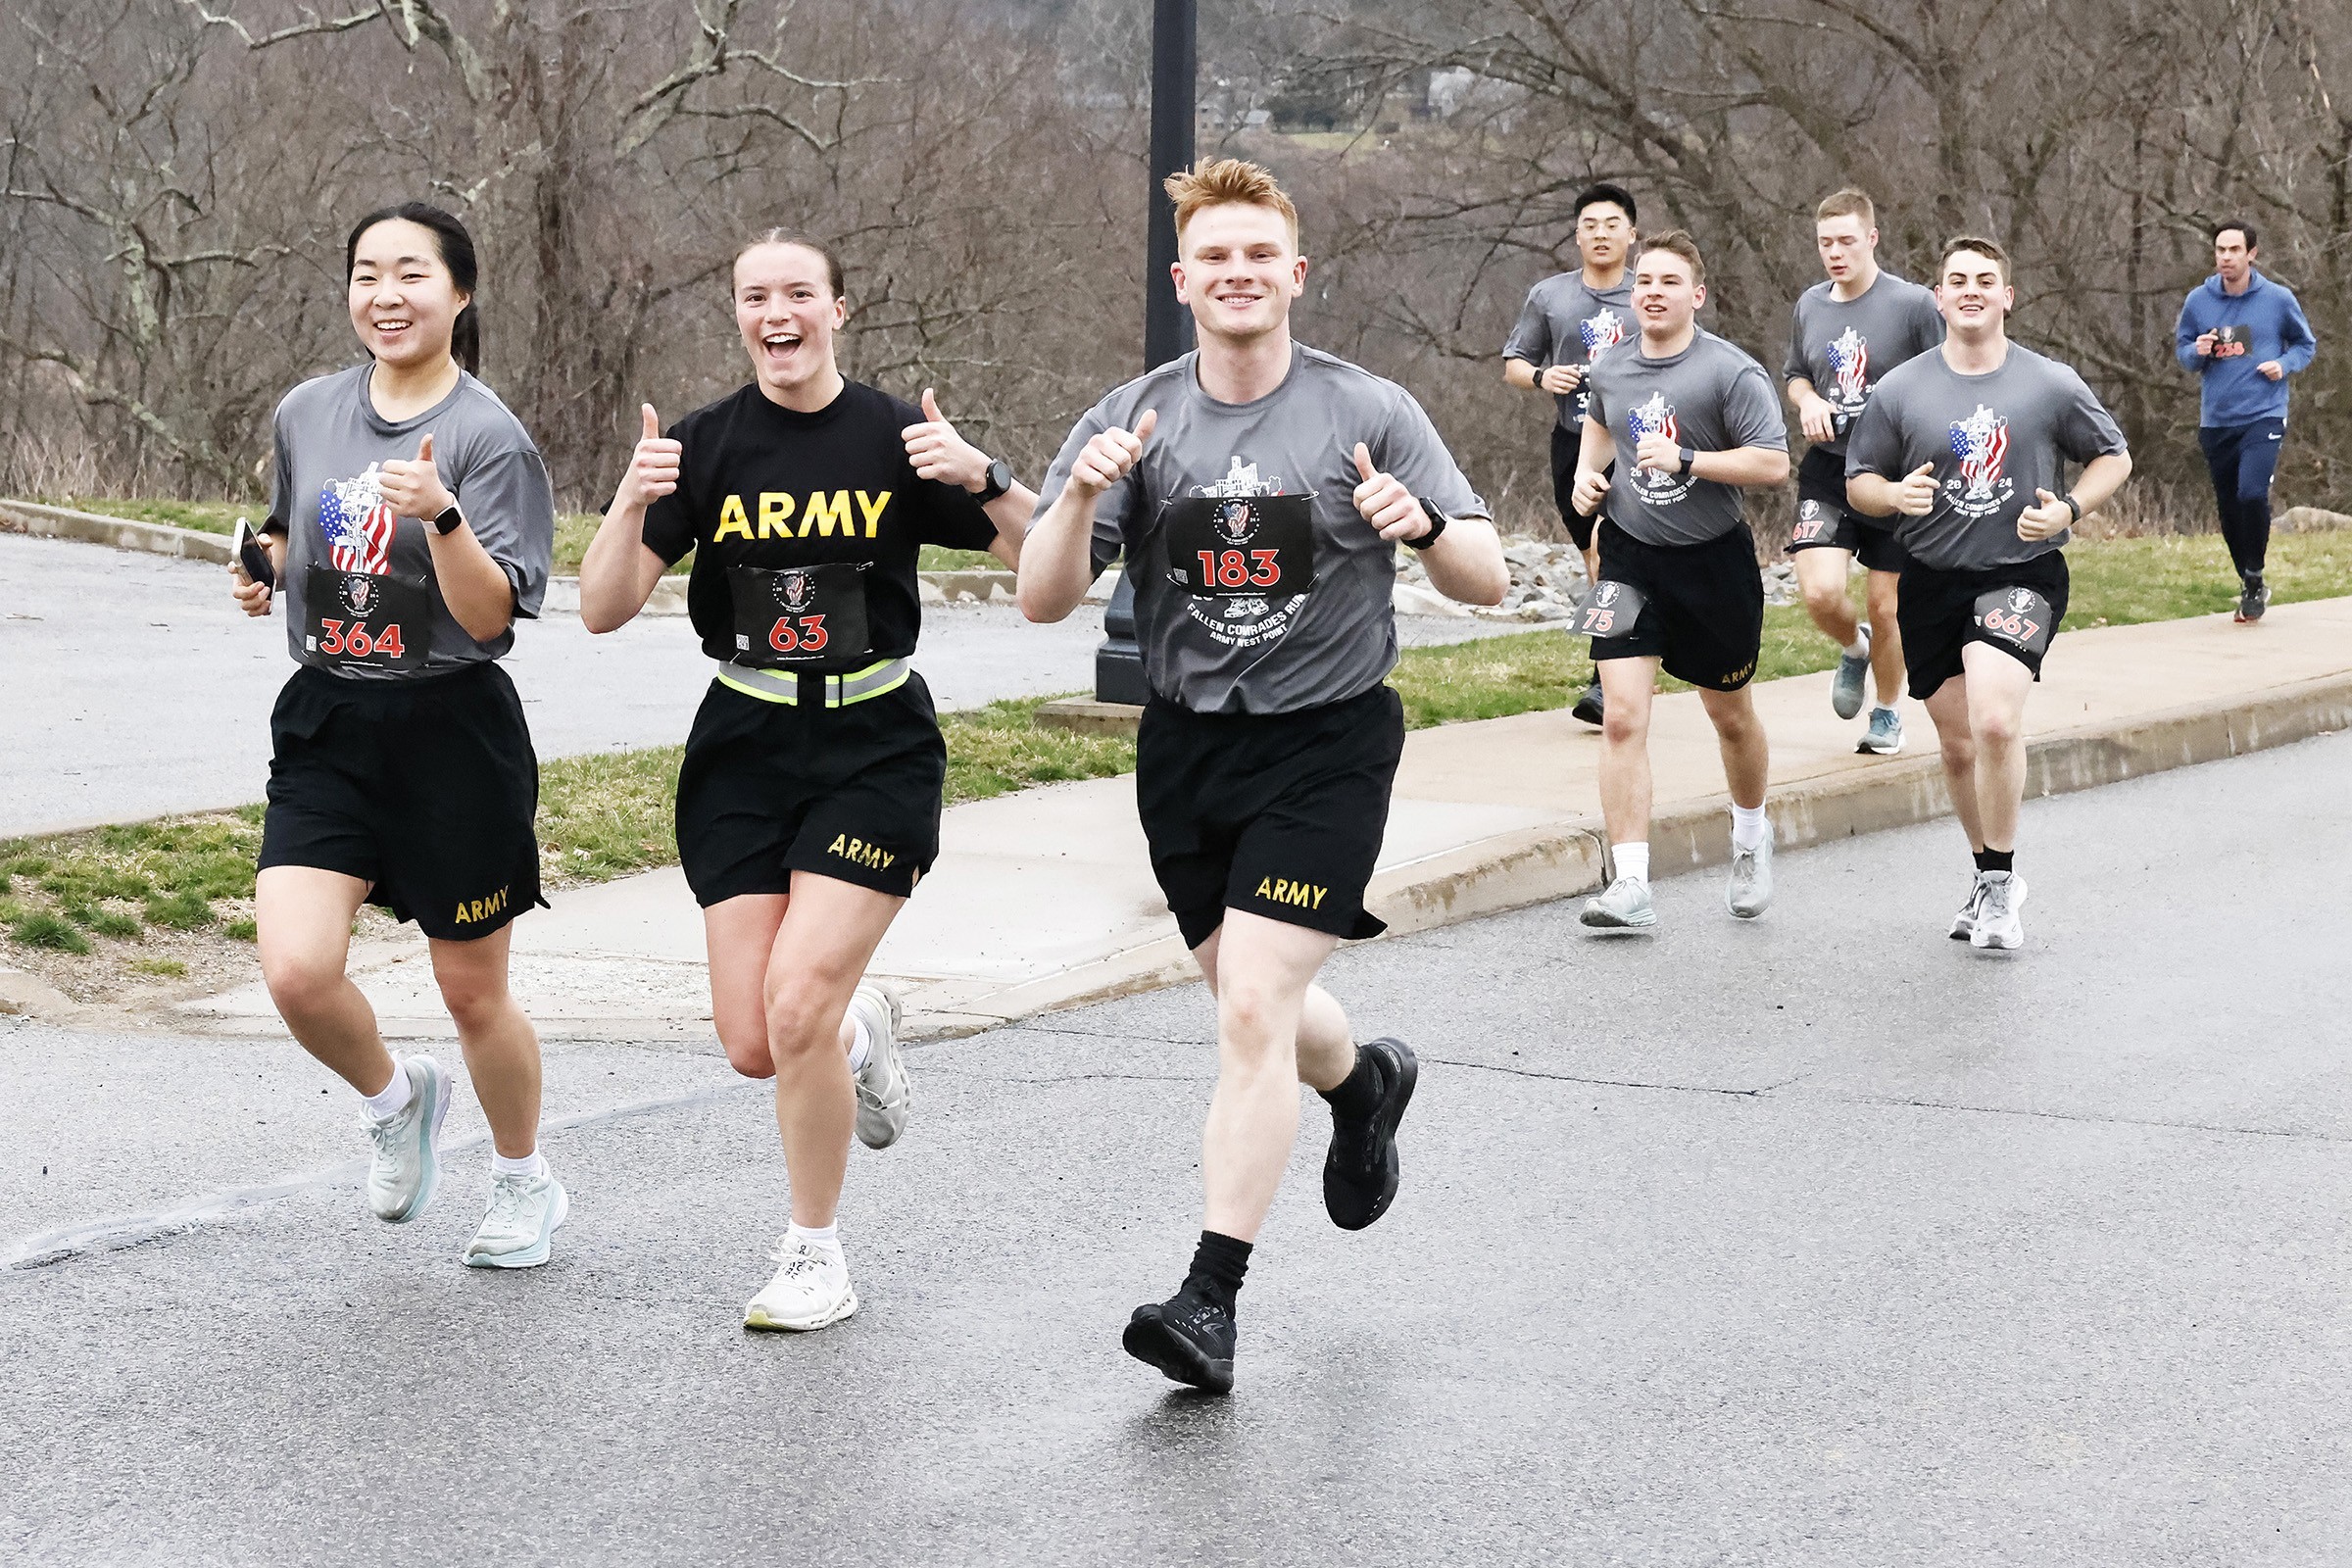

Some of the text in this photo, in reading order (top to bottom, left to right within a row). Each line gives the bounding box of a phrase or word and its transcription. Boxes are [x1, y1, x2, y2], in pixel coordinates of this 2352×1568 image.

[1649, 485, 1688, 499] COMRADES
[1946, 477, 2012, 489] 20 24
[713, 489, 893, 543] ARMY
[1964, 498, 2001, 511] COMRADES
[1792, 520, 1824, 540] 617
[1198, 549, 1281, 588] 183
[1187, 593, 1306, 637] FALLEN COMRADES RUN
[1582, 608, 1615, 632] 75
[1984, 608, 2039, 641] 667
[319, 617, 405, 659] 364
[768, 614, 829, 652] 63
[1209, 623, 1288, 648] ARMY WEST POINT
[1722, 659, 1753, 684] ARMY
[827, 833, 895, 872] ARMY
[455, 885, 509, 924] ARMY
[1254, 875, 1328, 910] ARMY
